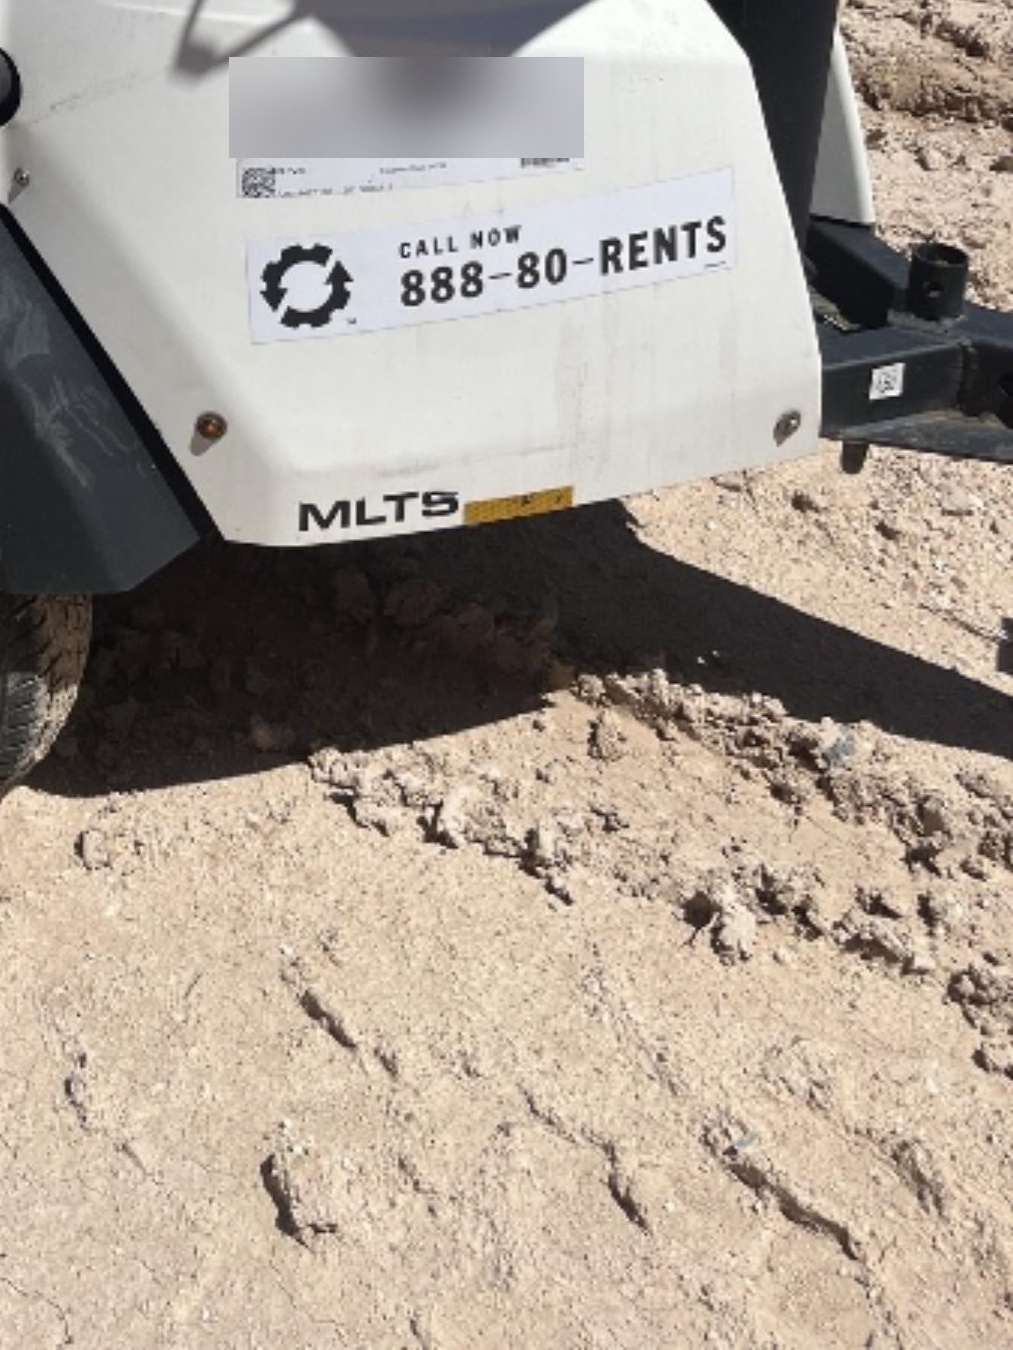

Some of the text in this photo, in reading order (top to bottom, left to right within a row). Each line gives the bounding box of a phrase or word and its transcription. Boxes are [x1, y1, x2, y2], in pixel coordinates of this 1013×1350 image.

[399, 225, 523, 259] CALL NOW
[400, 215, 727, 307] 888-80-RENTS
[298, 491, 459, 531] MLTS
